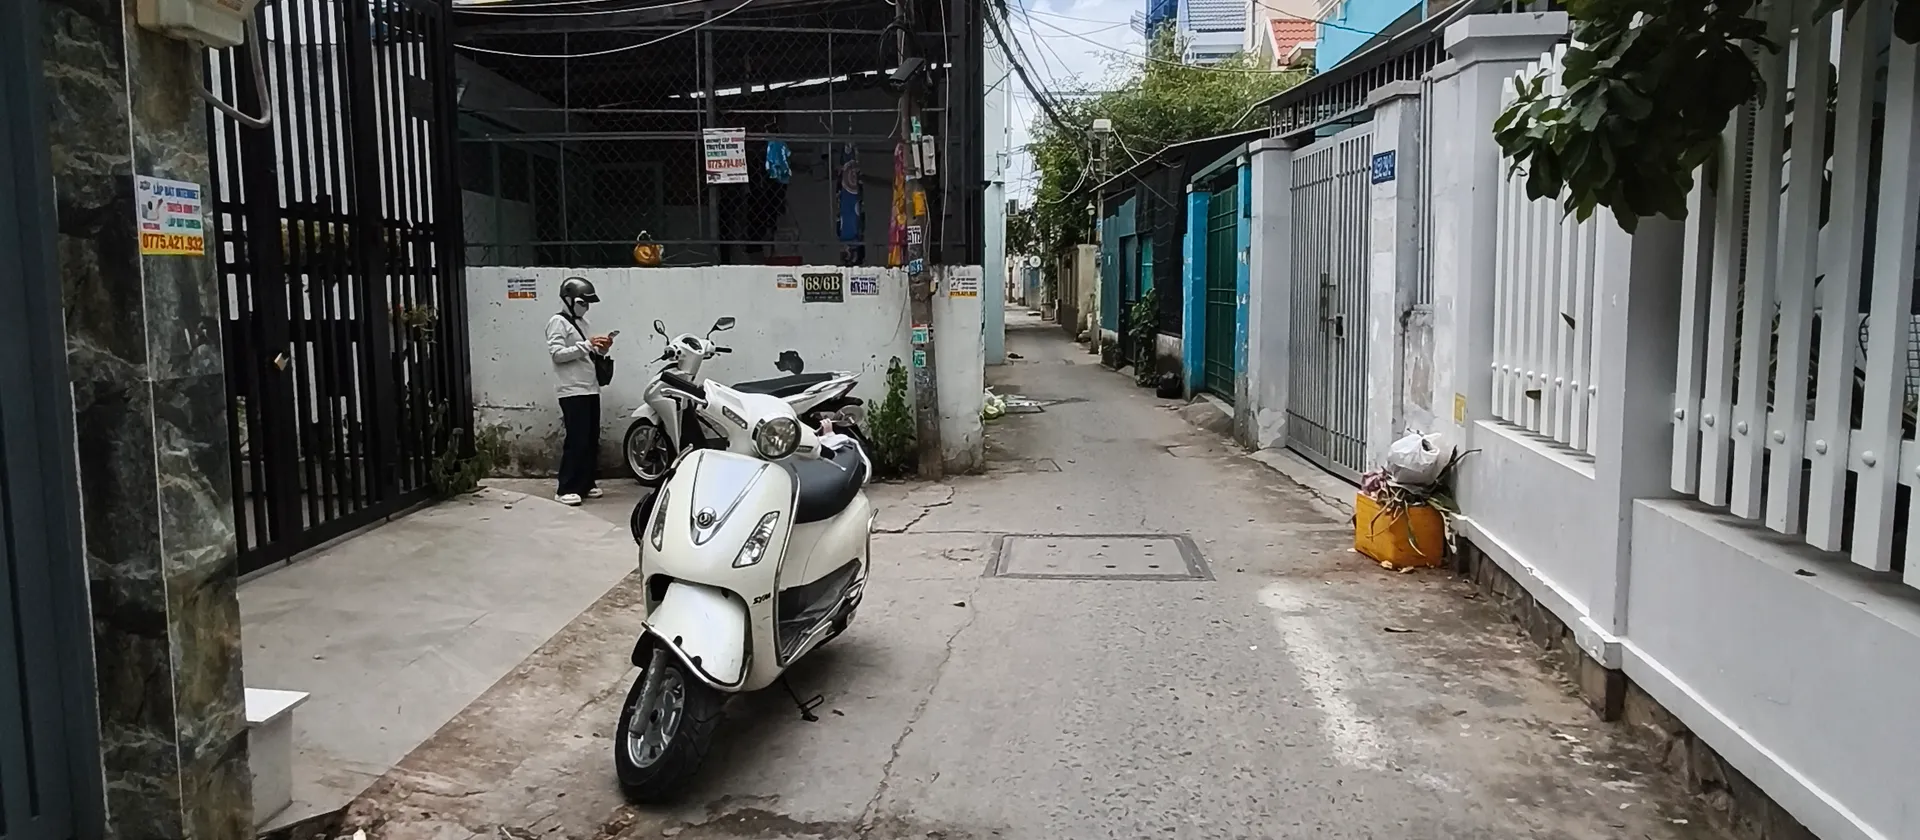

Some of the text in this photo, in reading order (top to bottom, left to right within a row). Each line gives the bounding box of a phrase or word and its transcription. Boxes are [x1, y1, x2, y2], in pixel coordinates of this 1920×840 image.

[142, 233, 204, 251] 0775.421.932
[805, 276, 840, 291] 68/6B
[753, 592, 771, 604] SYM
